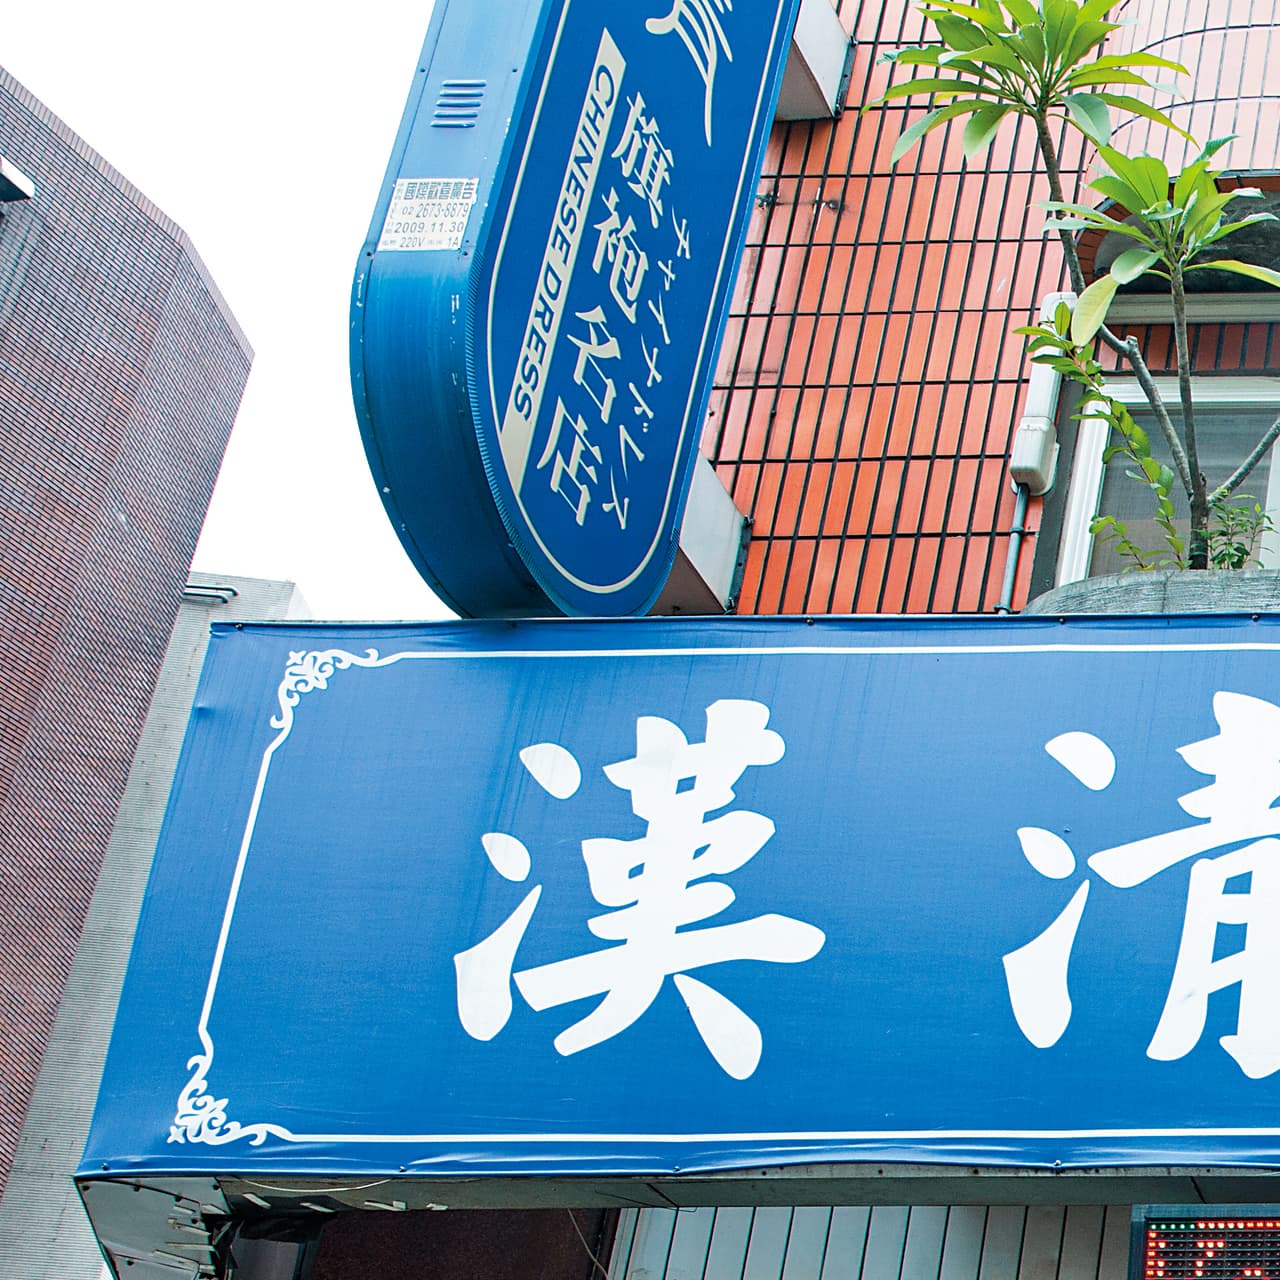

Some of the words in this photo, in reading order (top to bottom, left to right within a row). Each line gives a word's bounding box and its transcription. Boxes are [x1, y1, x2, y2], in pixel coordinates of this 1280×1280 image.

[394, 221, 465, 233] 2009.11.30
[550, 64, 615, 265] CHINESE
[514, 261, 562, 422] DRESS
[536, 91, 674, 527] 旗袍名店
